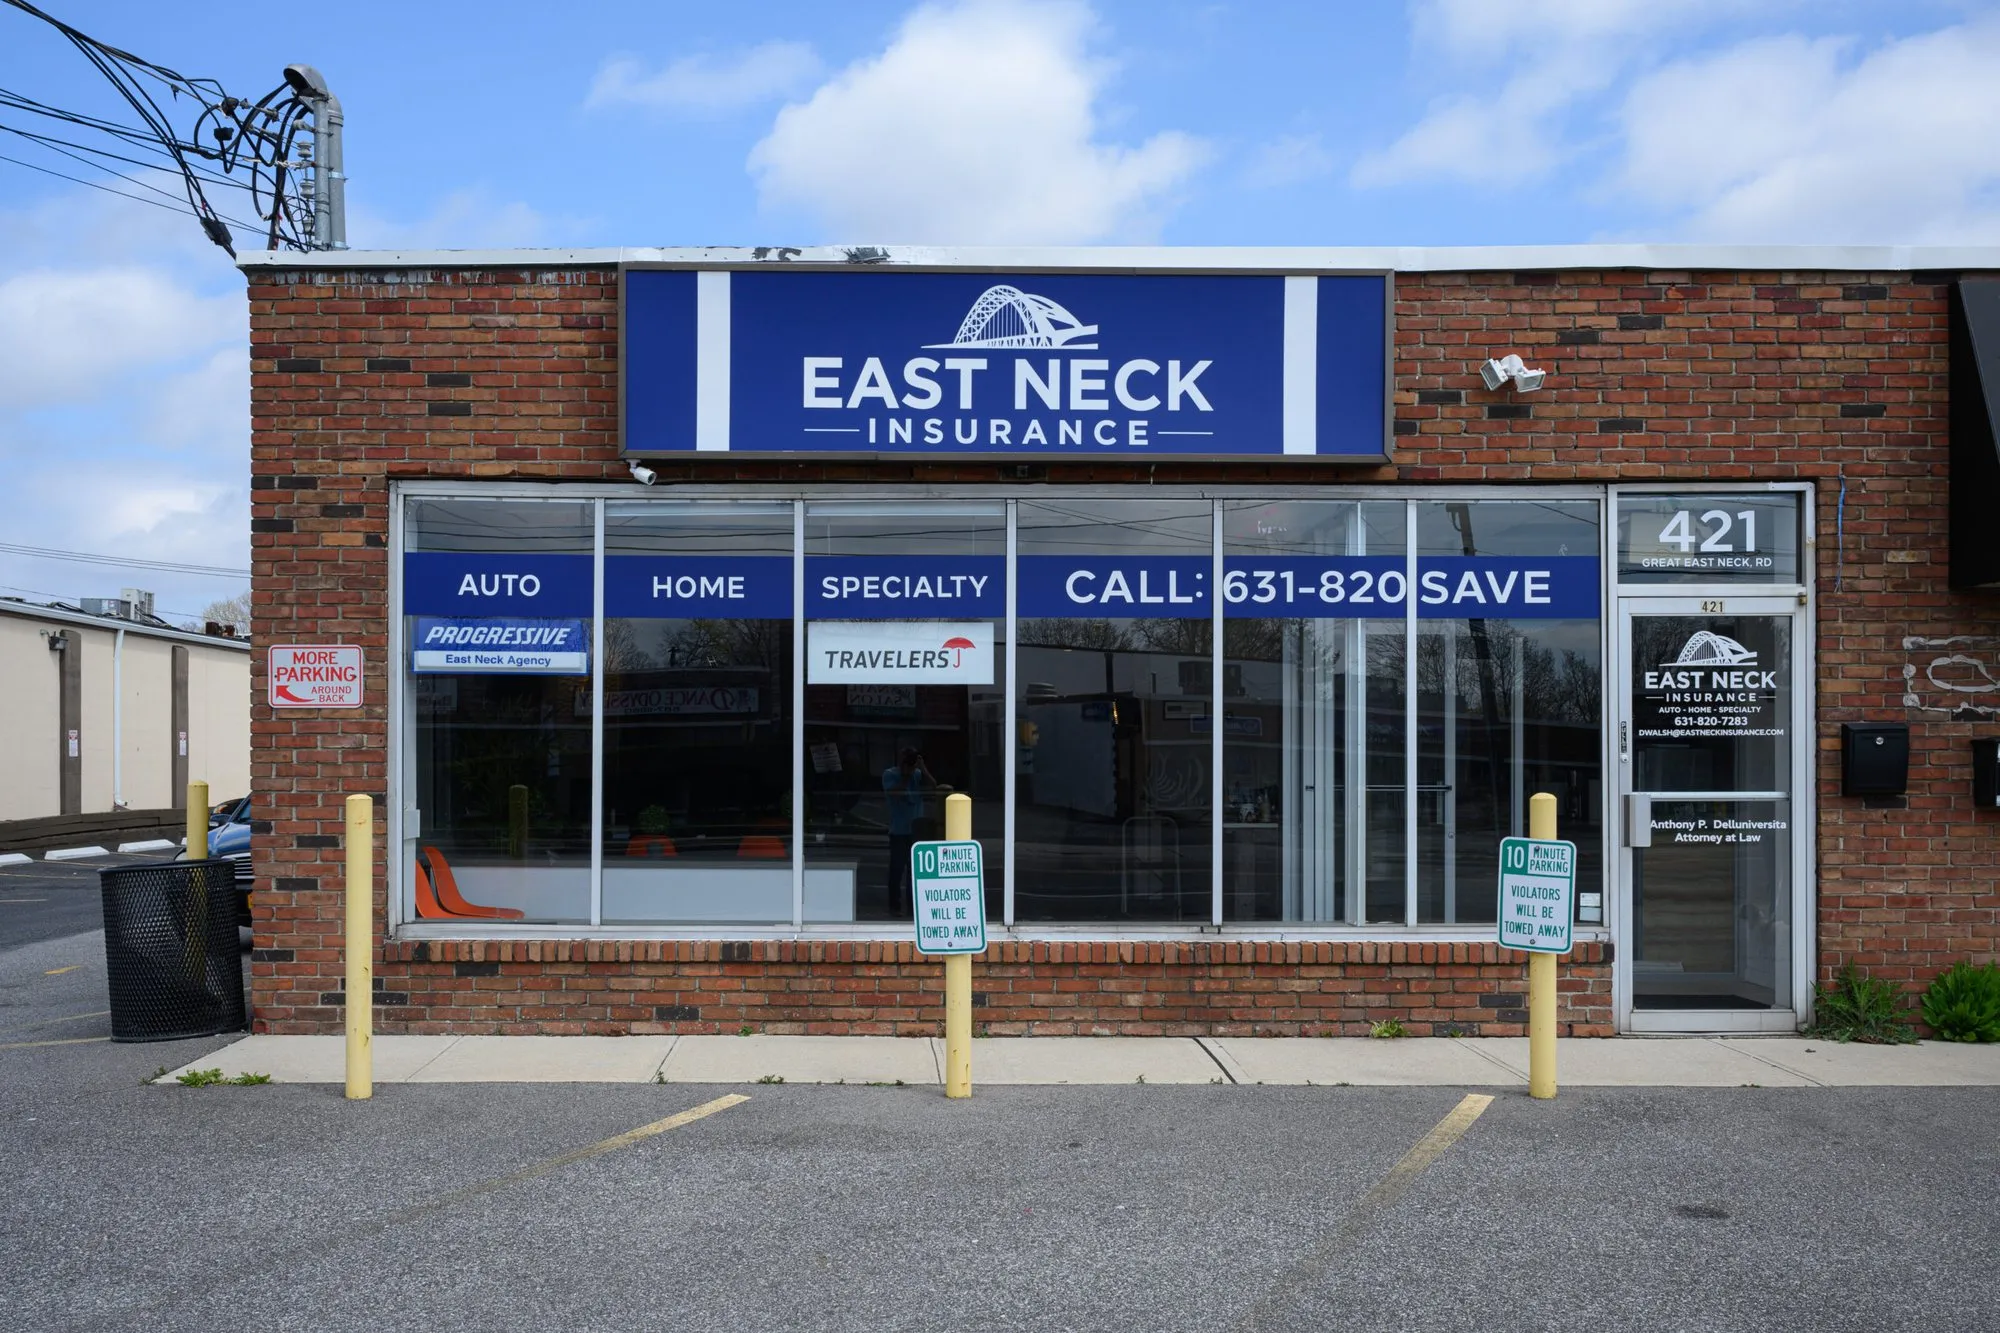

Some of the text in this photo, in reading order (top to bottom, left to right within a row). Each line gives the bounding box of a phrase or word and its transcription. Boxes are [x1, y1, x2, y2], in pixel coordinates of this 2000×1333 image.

[804, 357, 1213, 411] EAST NECK
[870, 418, 1148, 445] INSURANCE
[1659, 510, 1755, 552] 421
[1642, 558, 1681, 567] GREAT
[1684, 558, 1714, 567] EAST
[1755, 557, 1772, 567] RD
[458, 574, 540, 596] AUTO
[654, 576, 744, 598] HOME
[822, 576, 988, 598] SPECIALTY
[1066, 570, 1202, 603] CALL:
[1421, 571, 1550, 604] SAVE
[1702, 601, 1723, 612] 421
[425, 626, 570, 644] PROGRESSIVE
[293, 651, 338, 665] MORE
[446, 654, 551, 666] East Neck Agency
[825, 650, 949, 669] TRAVELERS
[277, 667, 356, 682] PARKING
[1645, 671, 1776, 688] EAST NECK
[311, 686, 352, 694] AROUND
[319, 695, 345, 703] BACK
[1667, 693, 1756, 702] INSURANCE
[1675, 717, 1748, 725] 631-820-7283
[1639, 729, 1784, 737] DWALSH@EASTNECKINSURANCE.COM
[1650, 820, 1786, 832] Anthony P. Delluniversita
[1675, 833, 1722, 844] Attorney
[1740, 833, 1761, 841] Law
[942, 848, 972, 860] MINUTE
[1506, 846, 1524, 868] 10
[1533, 847, 1566, 860] MINUTE
[918, 850, 935, 873] 10
[940, 861, 976, 873] PARKING
[1530, 860, 1568, 873] PARKING
[925, 889, 971, 901] VIOLATORS
[1511, 885, 1560, 900] VIOLATORS
[931, 908, 966, 920] WILL BE
[1516, 904, 1553, 918] WILL BE
[922, 925, 979, 938] TOWED AWAY
[1505, 921, 1565, 937] TOWED AWAY
